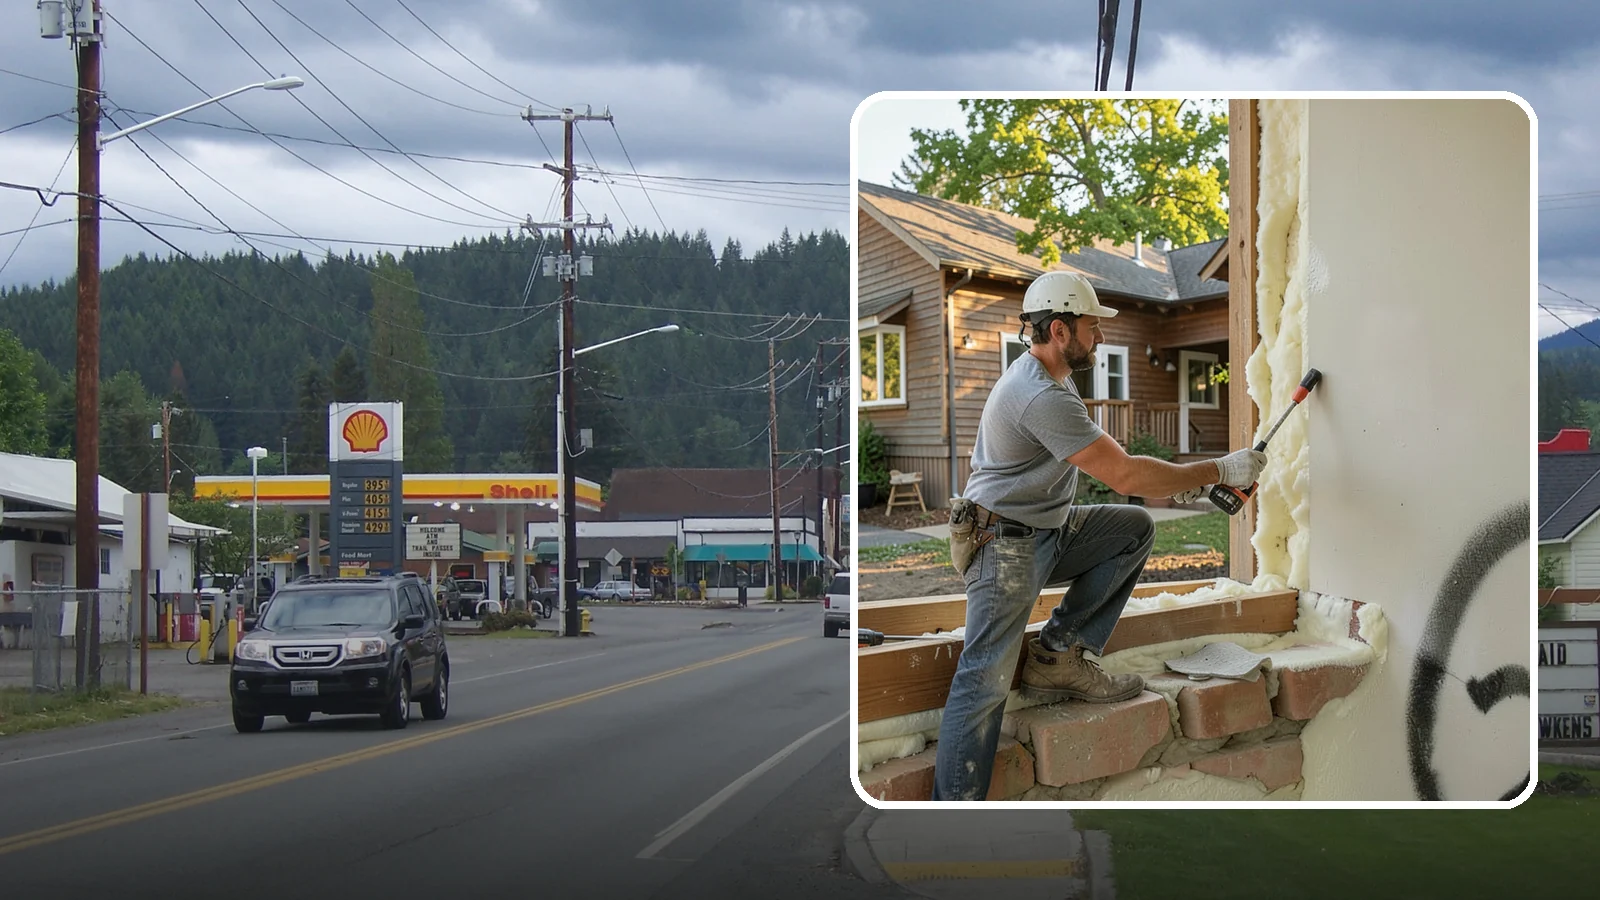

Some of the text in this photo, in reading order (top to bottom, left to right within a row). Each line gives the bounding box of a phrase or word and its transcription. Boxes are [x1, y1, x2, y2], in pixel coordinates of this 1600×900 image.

[366, 480, 383, 490] 395
[490, 484, 547, 499] Shell
[366, 494, 383, 504] 405
[366, 508, 383, 518] 415
[366, 522, 383, 533] 429
